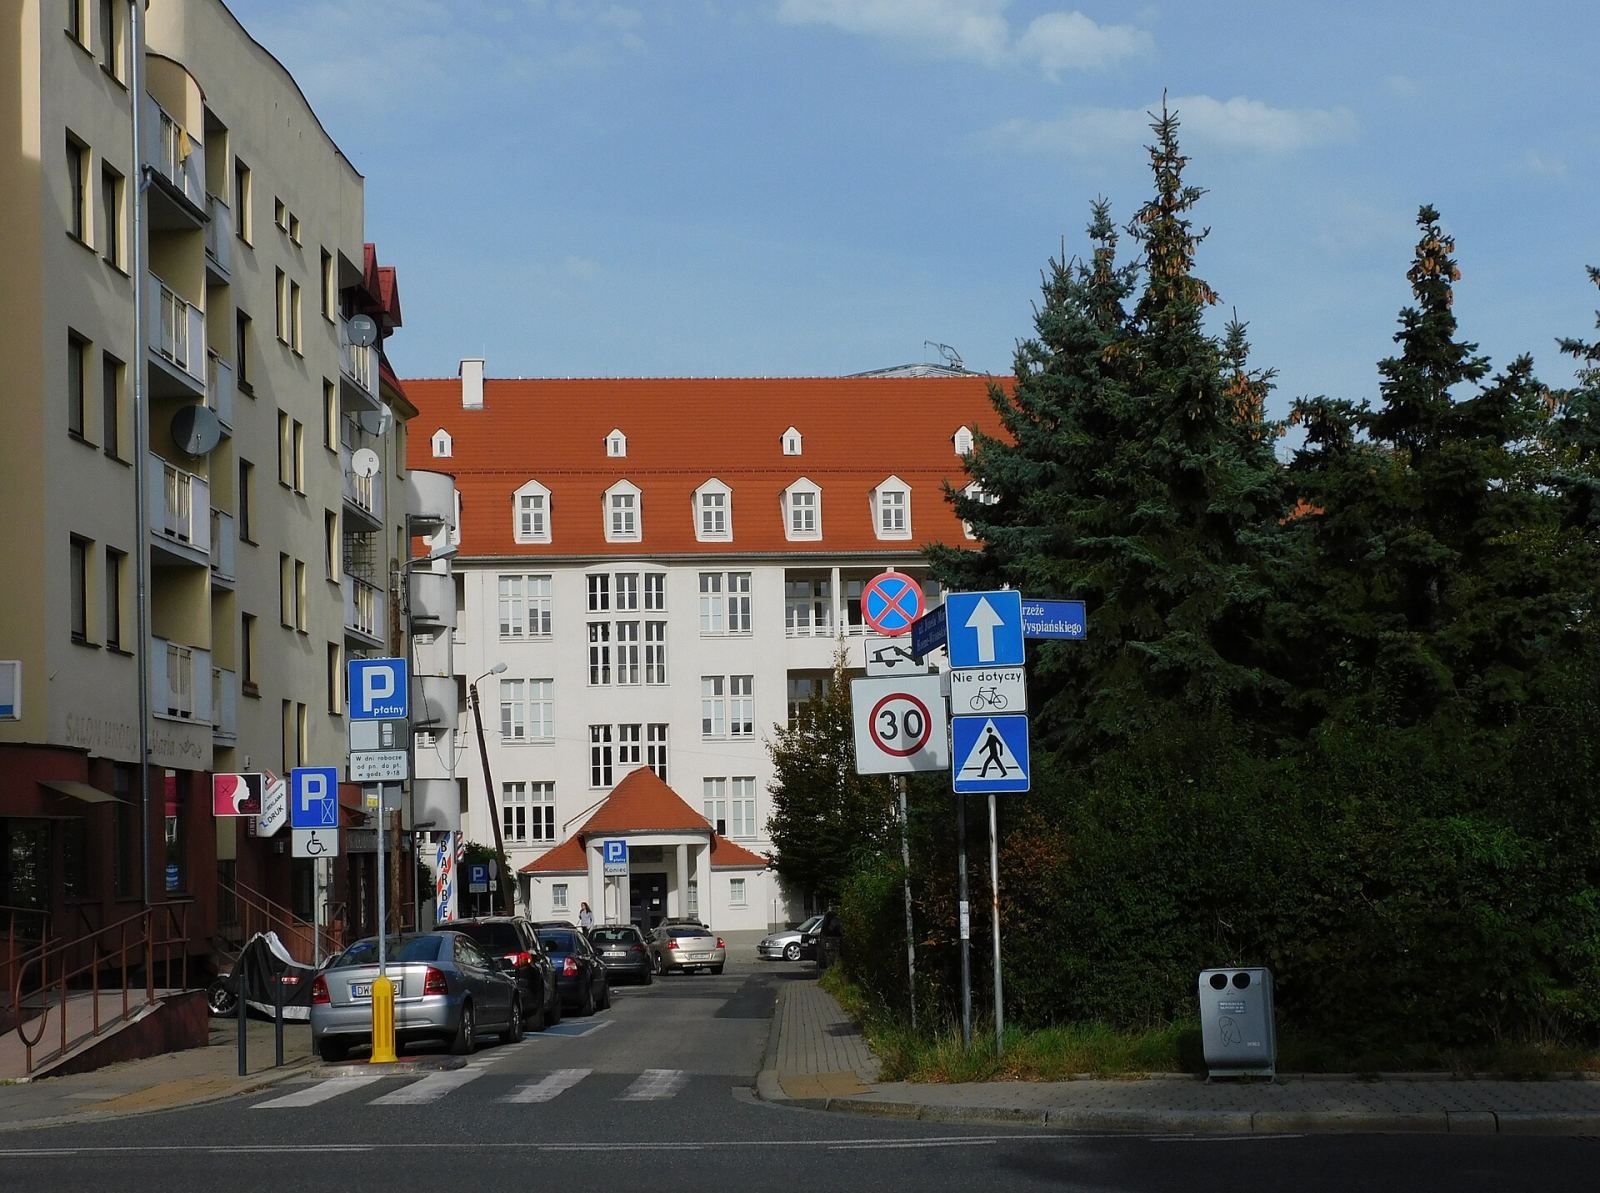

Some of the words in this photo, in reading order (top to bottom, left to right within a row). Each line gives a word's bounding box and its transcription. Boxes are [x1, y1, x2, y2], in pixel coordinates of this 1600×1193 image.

[1022, 604, 1045, 616] rzeże
[953, 672, 973, 683] Nie
[978, 671, 1022, 684] dotyczy
[362, 665, 395, 712] P
[373, 705, 404, 717] płatny
[879, 709, 924, 741] 30
[301, 774, 327, 811] P
[267, 805, 285, 824] DRUK
[608, 842, 622, 861] P
[472, 866, 484, 882] P
[357, 985, 371, 996] DW
